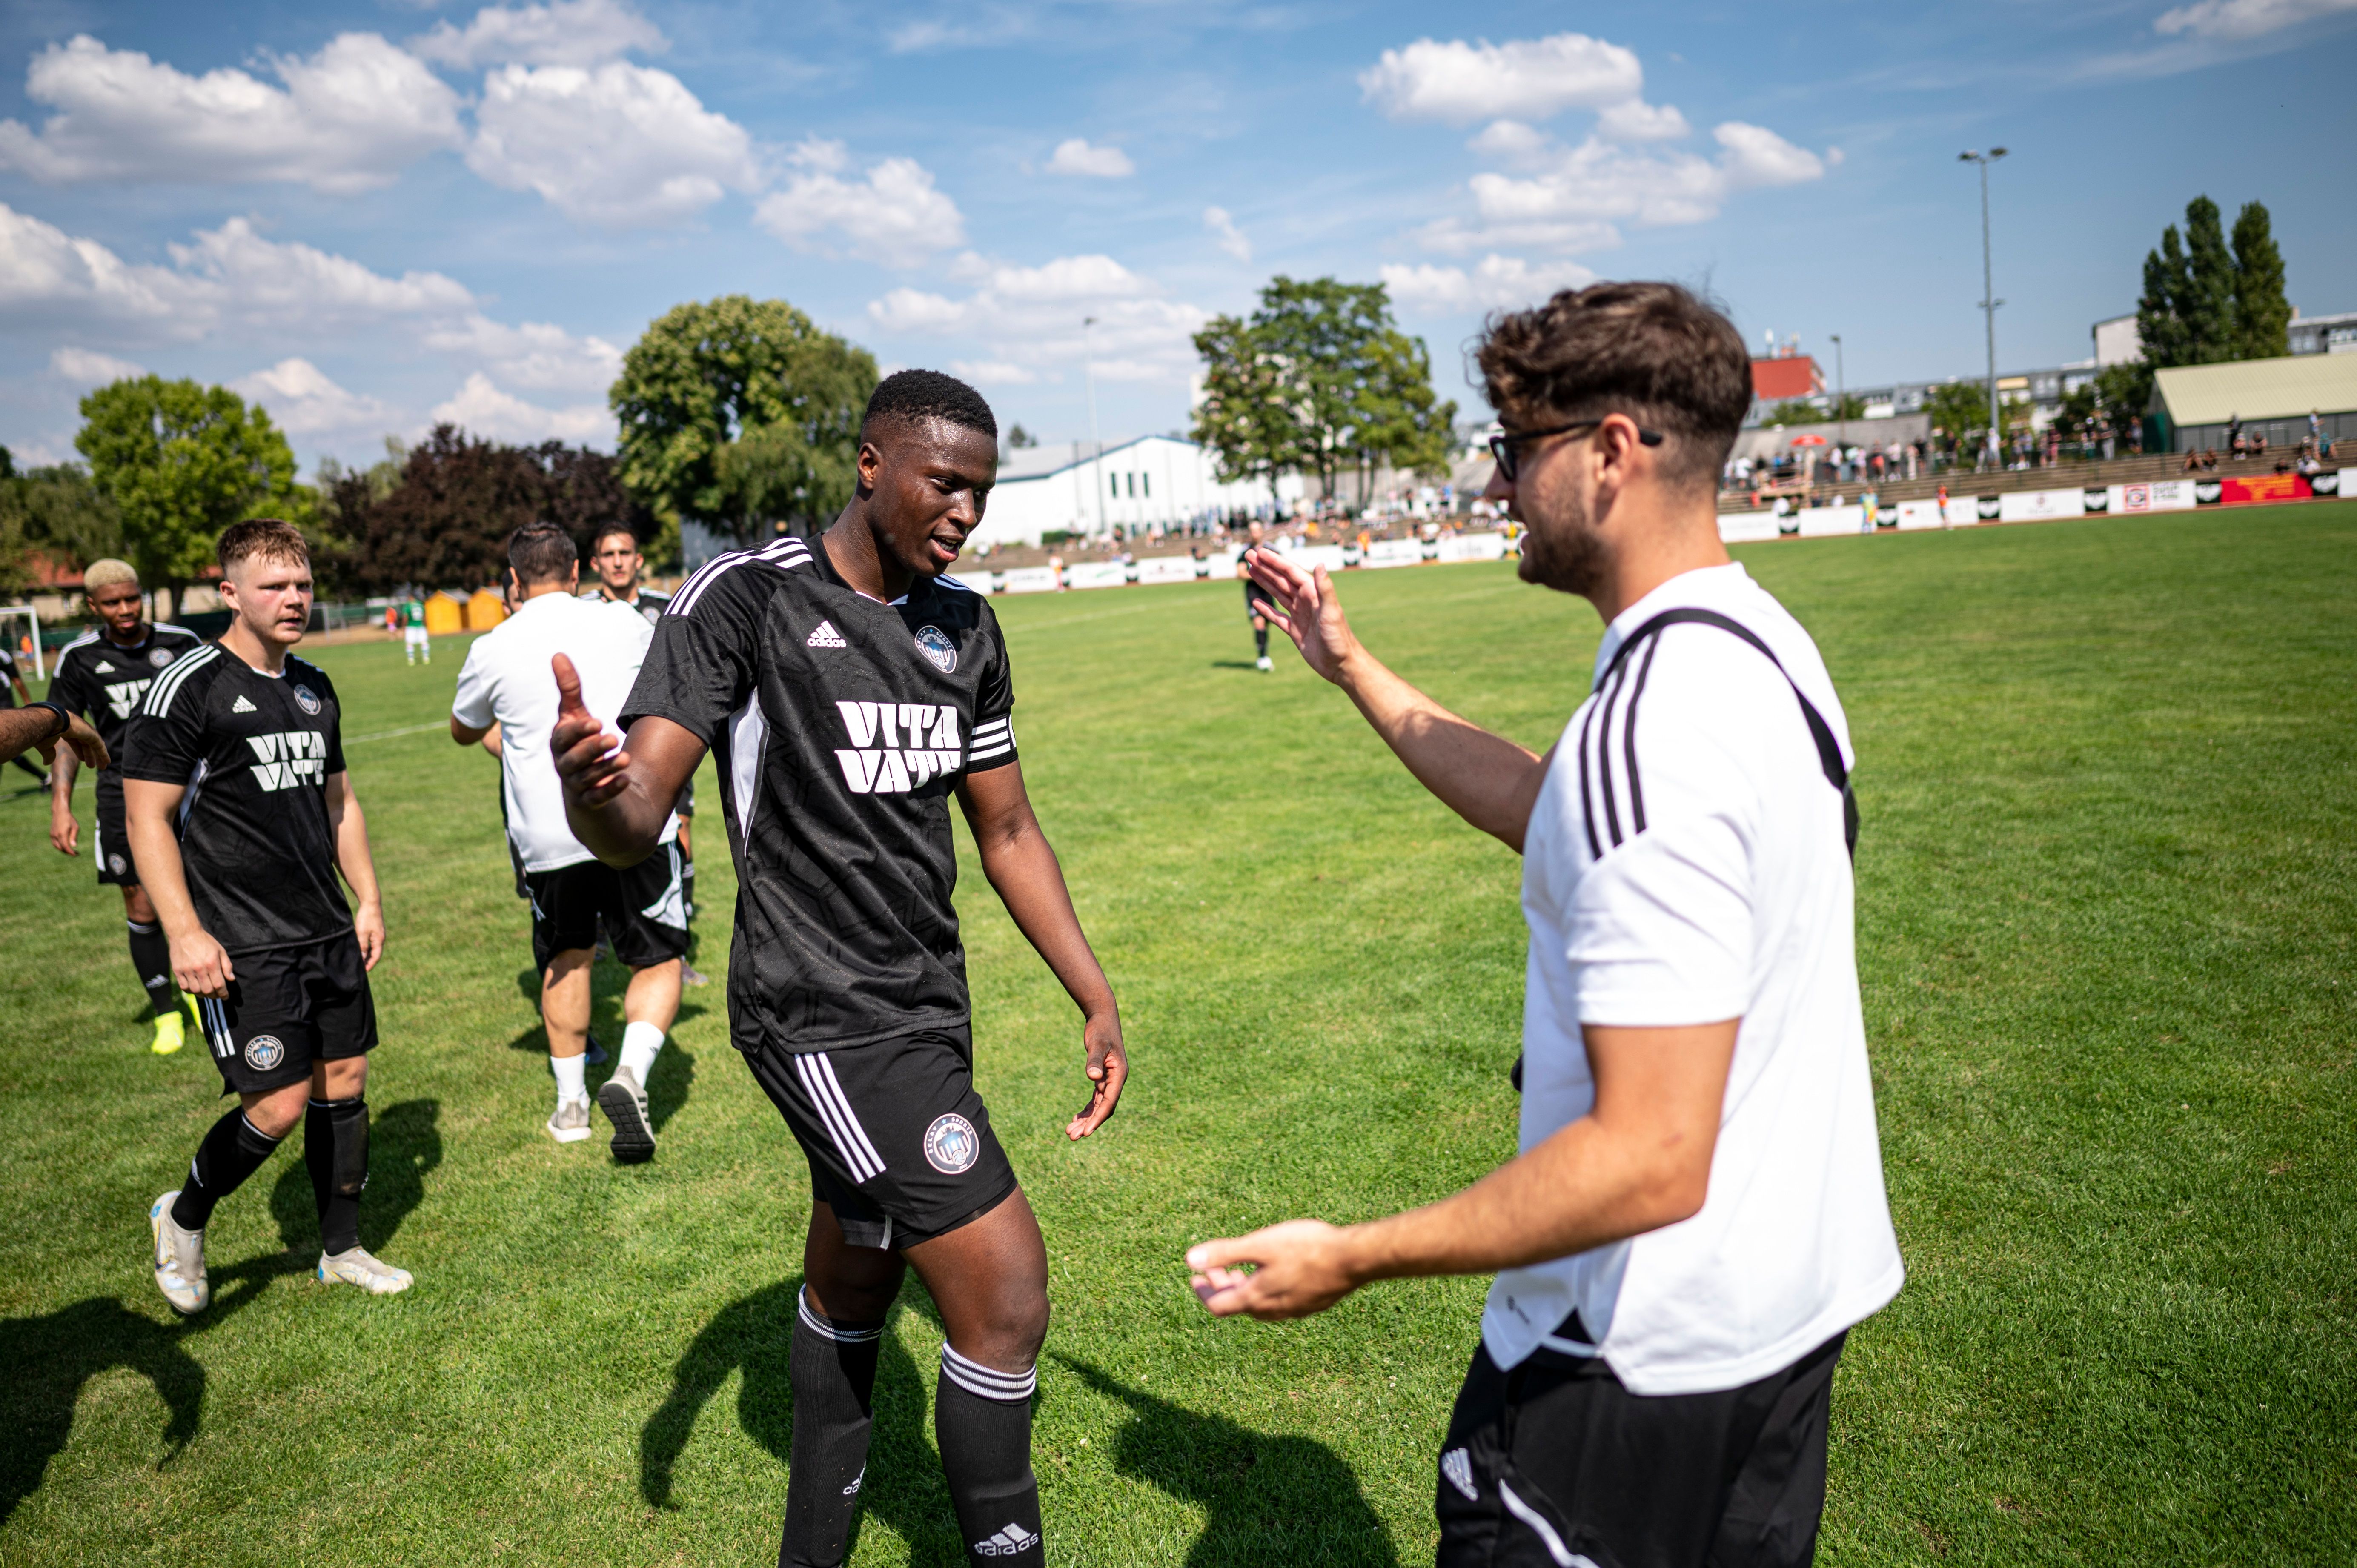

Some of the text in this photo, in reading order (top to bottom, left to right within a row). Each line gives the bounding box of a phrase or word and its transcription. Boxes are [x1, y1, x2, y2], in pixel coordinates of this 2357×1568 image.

[807, 637, 847, 647] adidas
[936, 632, 953, 652] SPORTS
[835, 701, 961, 748] VITA
[246, 731, 327, 764] VITA
[951, 1117, 973, 1135] SPORTS
[974, 1533, 1039, 1556] adidas
